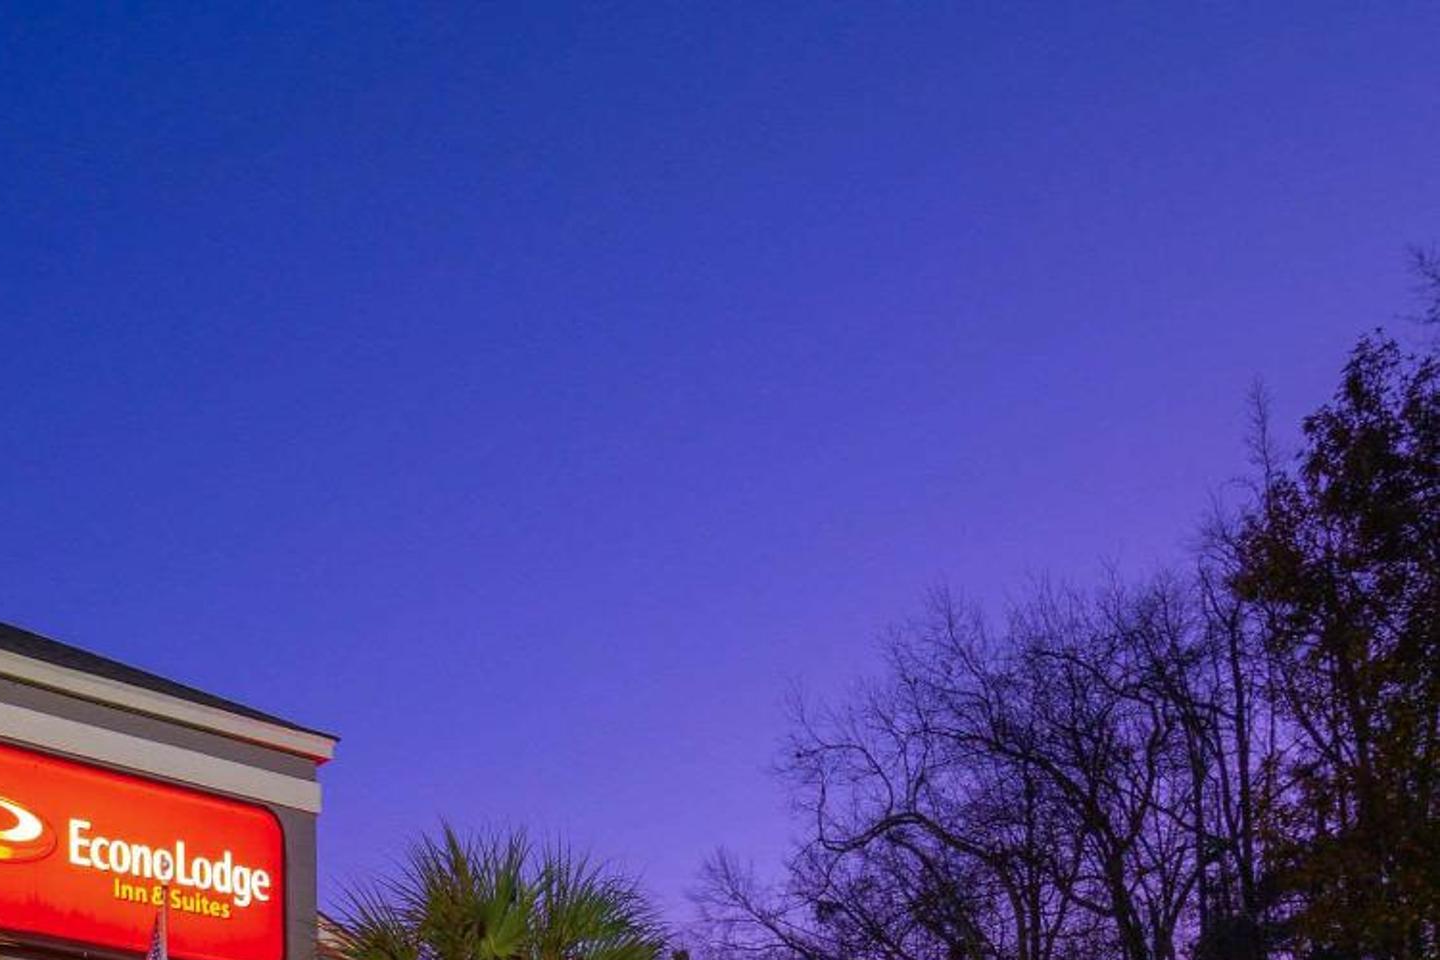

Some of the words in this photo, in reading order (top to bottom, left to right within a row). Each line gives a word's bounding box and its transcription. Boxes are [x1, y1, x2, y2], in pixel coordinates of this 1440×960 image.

[114, 878, 148, 903] Inn
[151, 886, 165, 906] &
[170, 889, 230, 918] Suites
